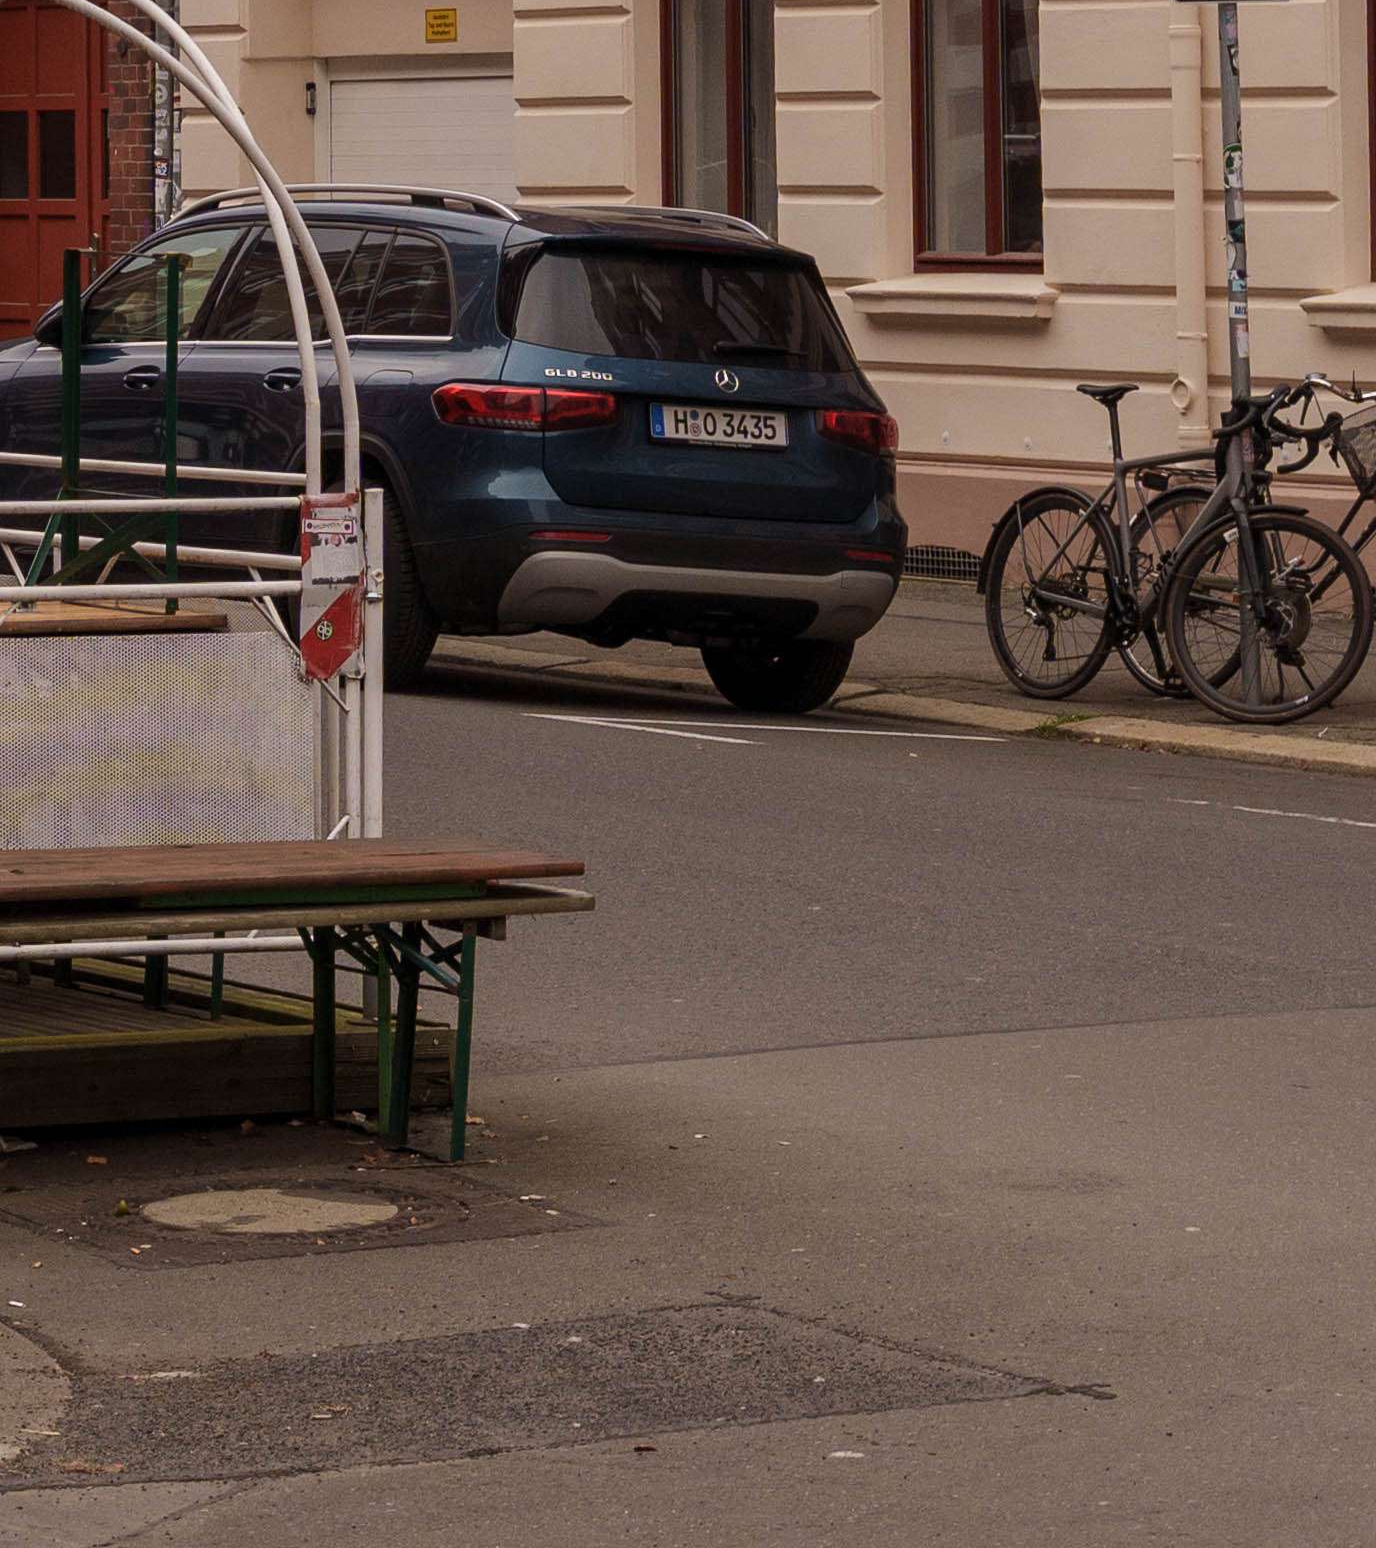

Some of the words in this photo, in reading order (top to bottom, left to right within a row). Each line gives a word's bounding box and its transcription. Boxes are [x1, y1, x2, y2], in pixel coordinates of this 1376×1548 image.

[545, 368, 577, 378] GLB
[581, 370, 613, 380] 200
[674, 409, 688, 434] H
[723, 412, 777, 440] 3435
